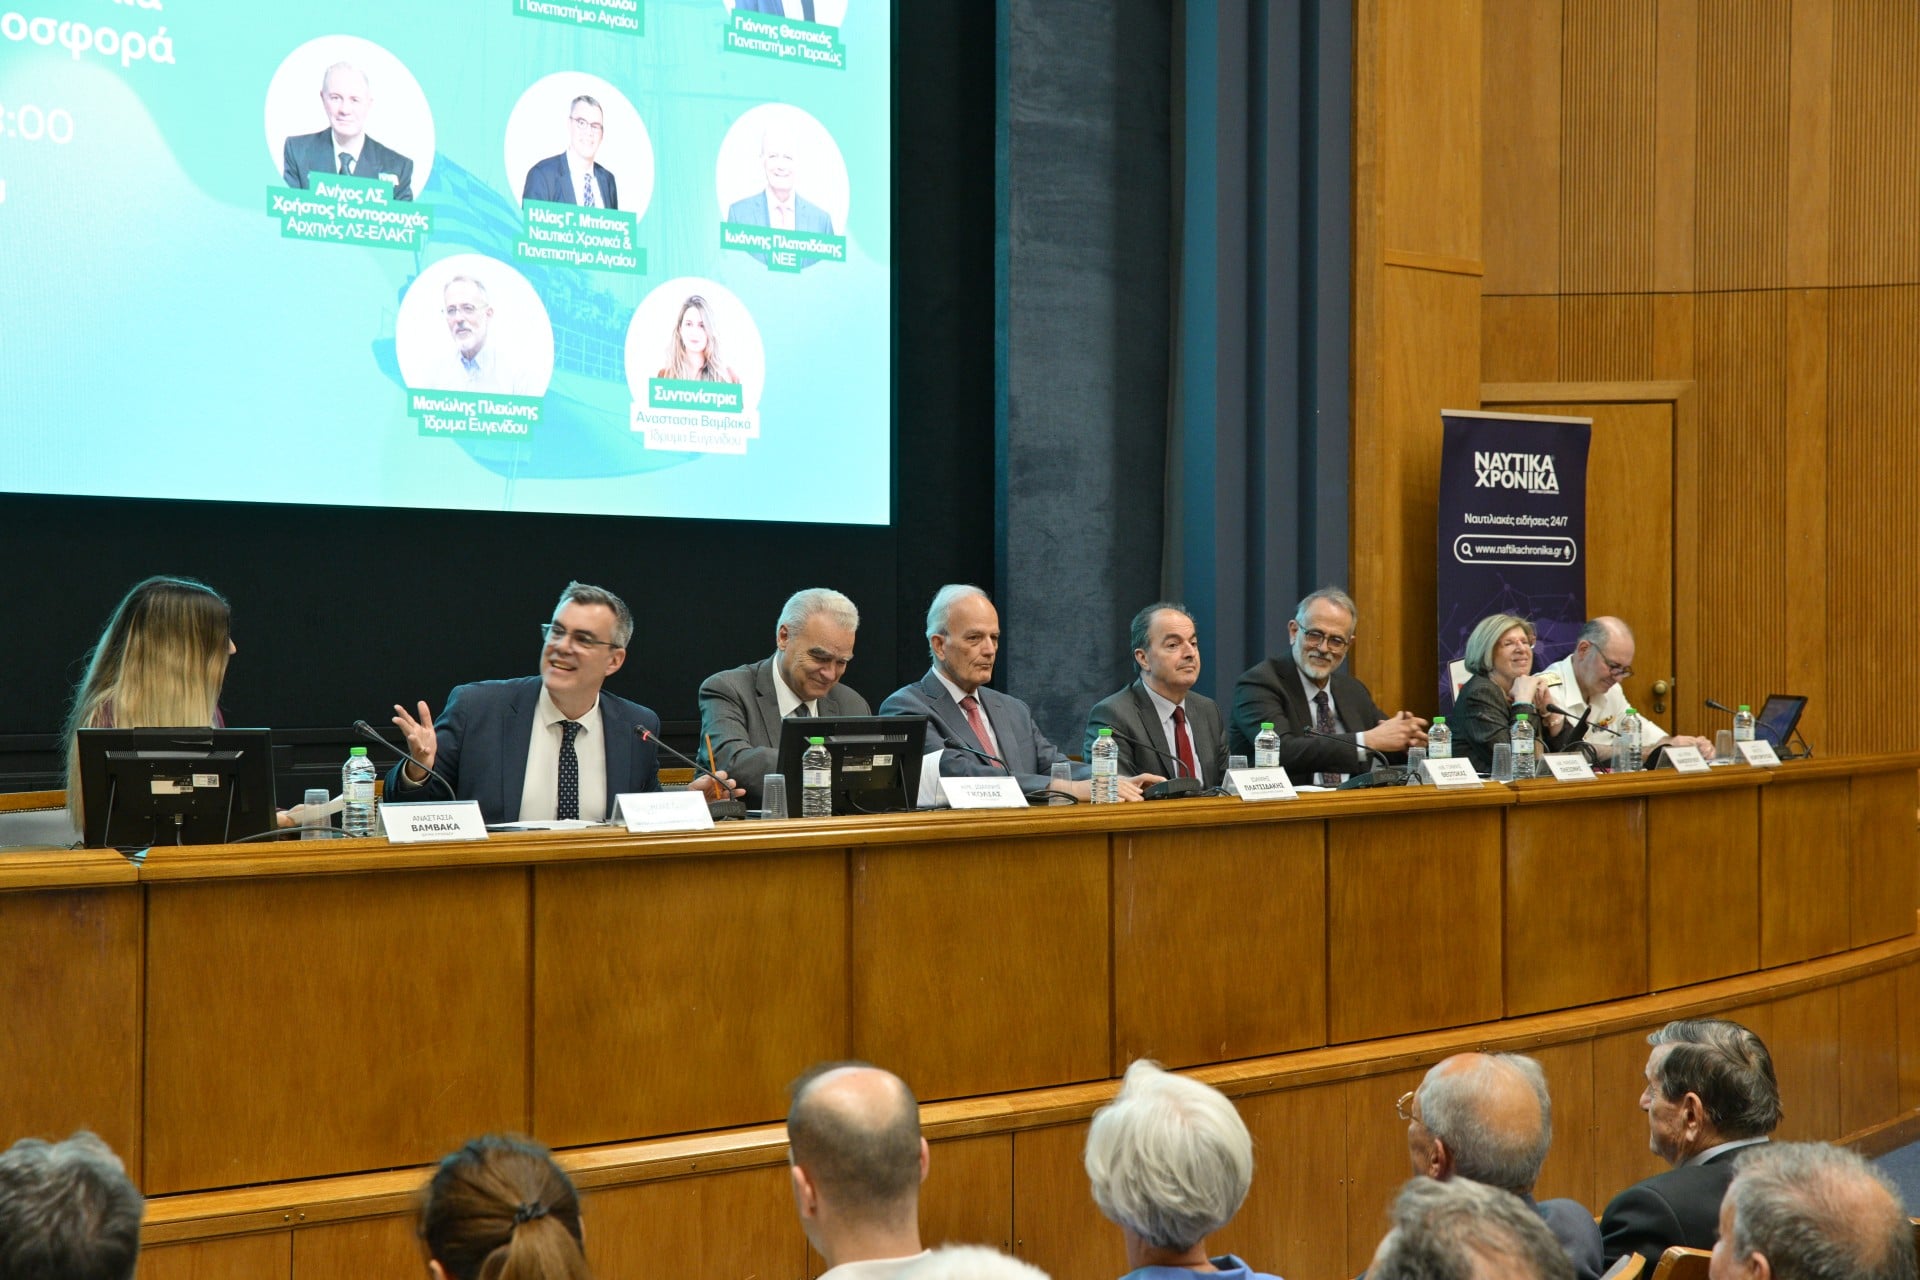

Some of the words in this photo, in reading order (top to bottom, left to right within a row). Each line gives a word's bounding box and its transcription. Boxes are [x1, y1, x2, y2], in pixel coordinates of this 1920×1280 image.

[598, 10, 637, 28] Αιγαίου
[736, 16, 778, 39] Γιάννης
[780, 24, 831, 47] Θεοτοκάς
[728, 32, 795, 56] Πανεπιστήμιο
[798, 44, 841, 66] Πειραιώς
[272, 195, 334, 218] Χρήστος
[337, 203, 428, 229] Κοντορουχάς
[529, 208, 563, 228] Ηλίας
[287, 216, 343, 238] Αρχηγός
[345, 223, 415, 242] ΛΣ-ΕΛΑΚΤ
[529, 226, 573, 243] Ναυτικά
[576, 231, 619, 247] Χρονικά
[623, 237, 631, 249] &
[725, 229, 770, 249] Ιωάννης
[773, 234, 842, 257] Πλατσιδάκης
[518, 242, 593, 264] Πανεπιστήμιο
[596, 250, 636, 267] Αιγαίου
[772, 252, 796, 266] ΝΕΕ
[654, 386, 736, 407] Συντονίστρια
[413, 396, 475, 416] Μανώλης
[478, 400, 538, 419] Πλειώνης
[423, 415, 465, 432] Ίδρυμα
[469, 418, 527, 435] Ευγενίδου
[636, 411, 697, 425] Αναστασία
[701, 415, 750, 429] Βαμβακά
[689, 431, 740, 445] Ευγενίδου
[1474, 451, 1553, 472] ΝΑΥΤΙΚΑ
[1474, 469, 1559, 489] ΧΡΟΝΙΚΑ
[1464, 513, 1514, 526] Ναυτιλιακές
[1516, 515, 1548, 527] ειδήσεις
[1550, 516, 1567, 526] 24/7
[1475, 544, 1561, 557] www.naftikachronika.gr
[410, 823, 460, 831] ΒΑΜΒΑΚΑ
